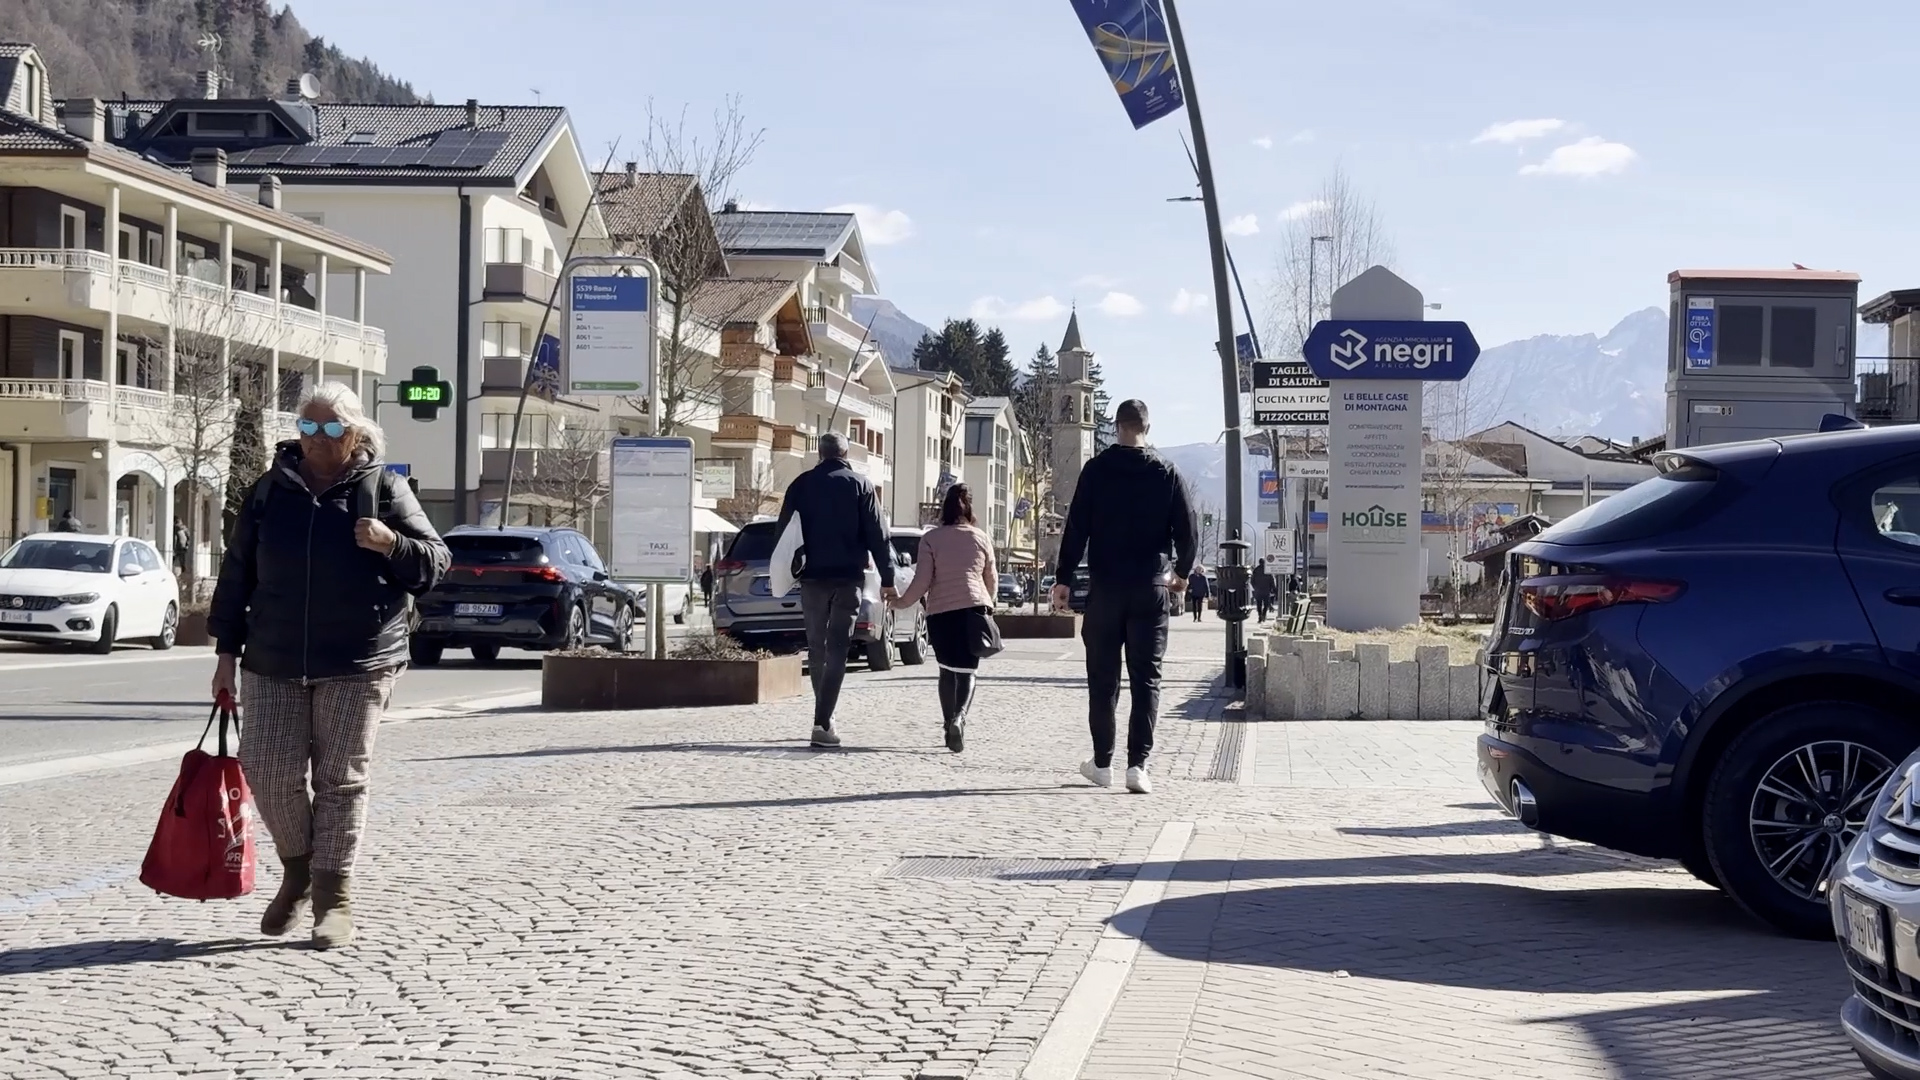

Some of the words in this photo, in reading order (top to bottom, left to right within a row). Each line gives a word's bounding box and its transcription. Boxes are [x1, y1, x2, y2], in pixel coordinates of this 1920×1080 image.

[1374, 337, 1453, 369] negri
[1268, 377, 1280, 386] DI
[1282, 377, 1322, 386] SALUMI
[409, 387, 440, 400] 10:20
[1343, 393, 1354, 401] LE
[1356, 393, 1384, 401] BELLE
[1385, 393, 1409, 401] CASE
[1257, 395, 1296, 404] CUCINA
[1356, 404, 1408, 412] MONTAGNA
[1342, 512, 1407, 527] HOUSE
[649, 542, 669, 550] TAXI
